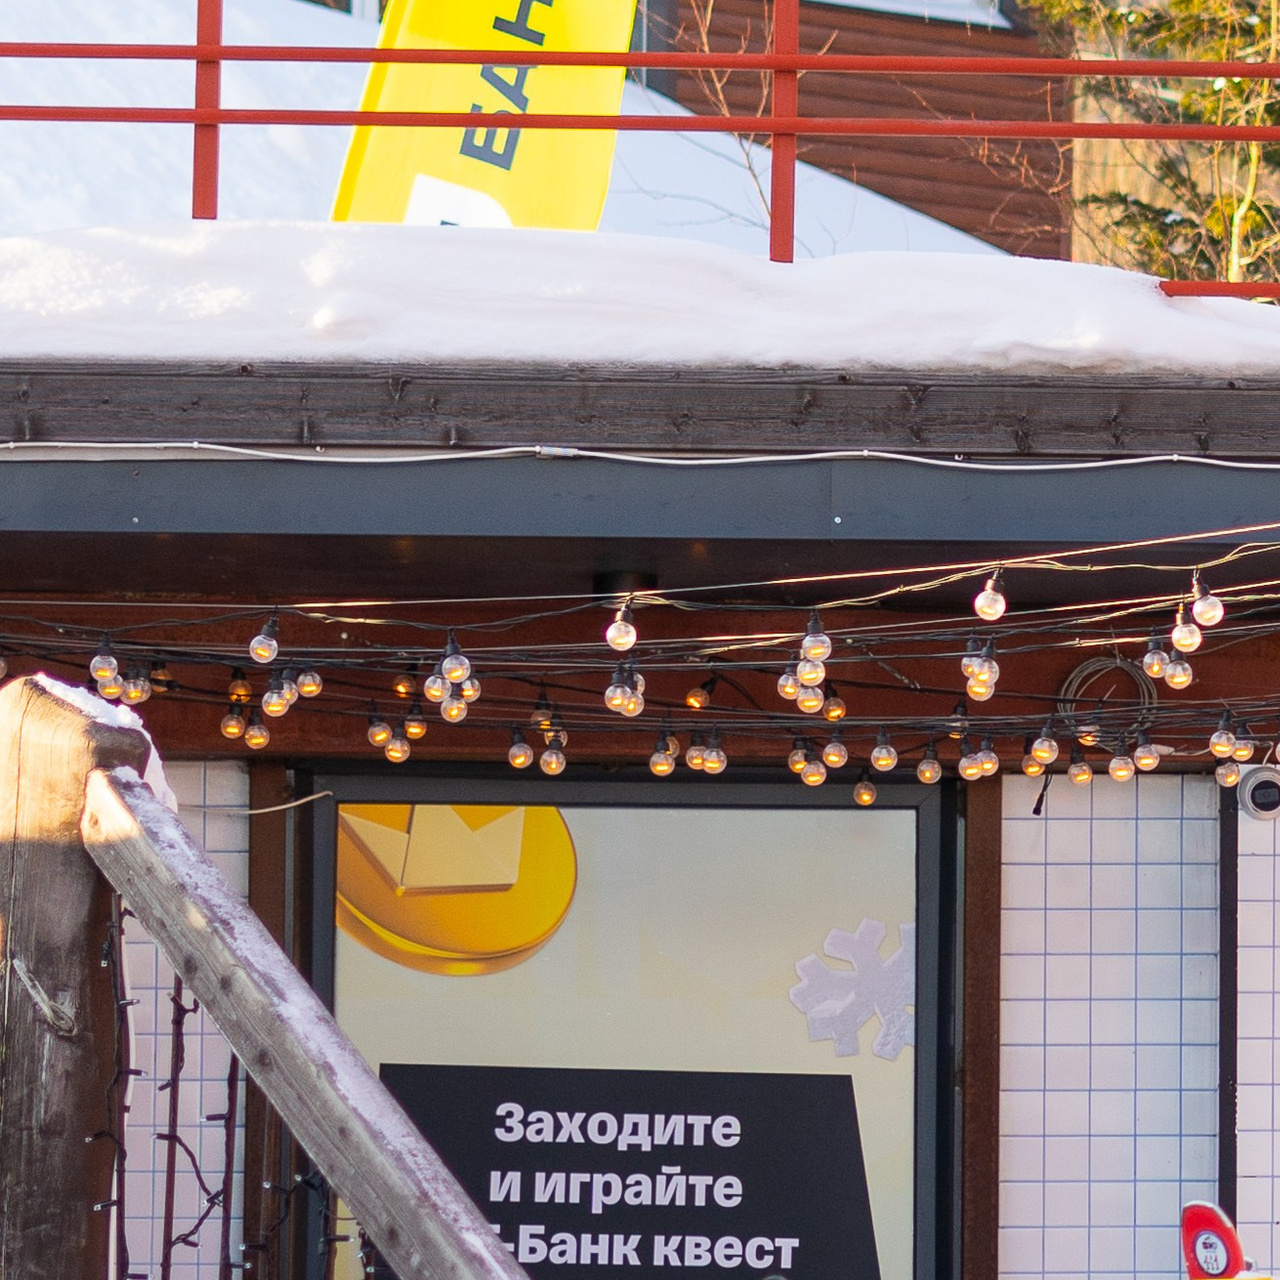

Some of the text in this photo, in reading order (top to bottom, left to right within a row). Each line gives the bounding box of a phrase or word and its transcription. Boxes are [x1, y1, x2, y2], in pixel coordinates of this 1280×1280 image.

[494, 1101, 742, 1152] Заходите
[488, 1164, 743, 1214] и играйте
[489, 1224, 800, 1269] -Банк квест
